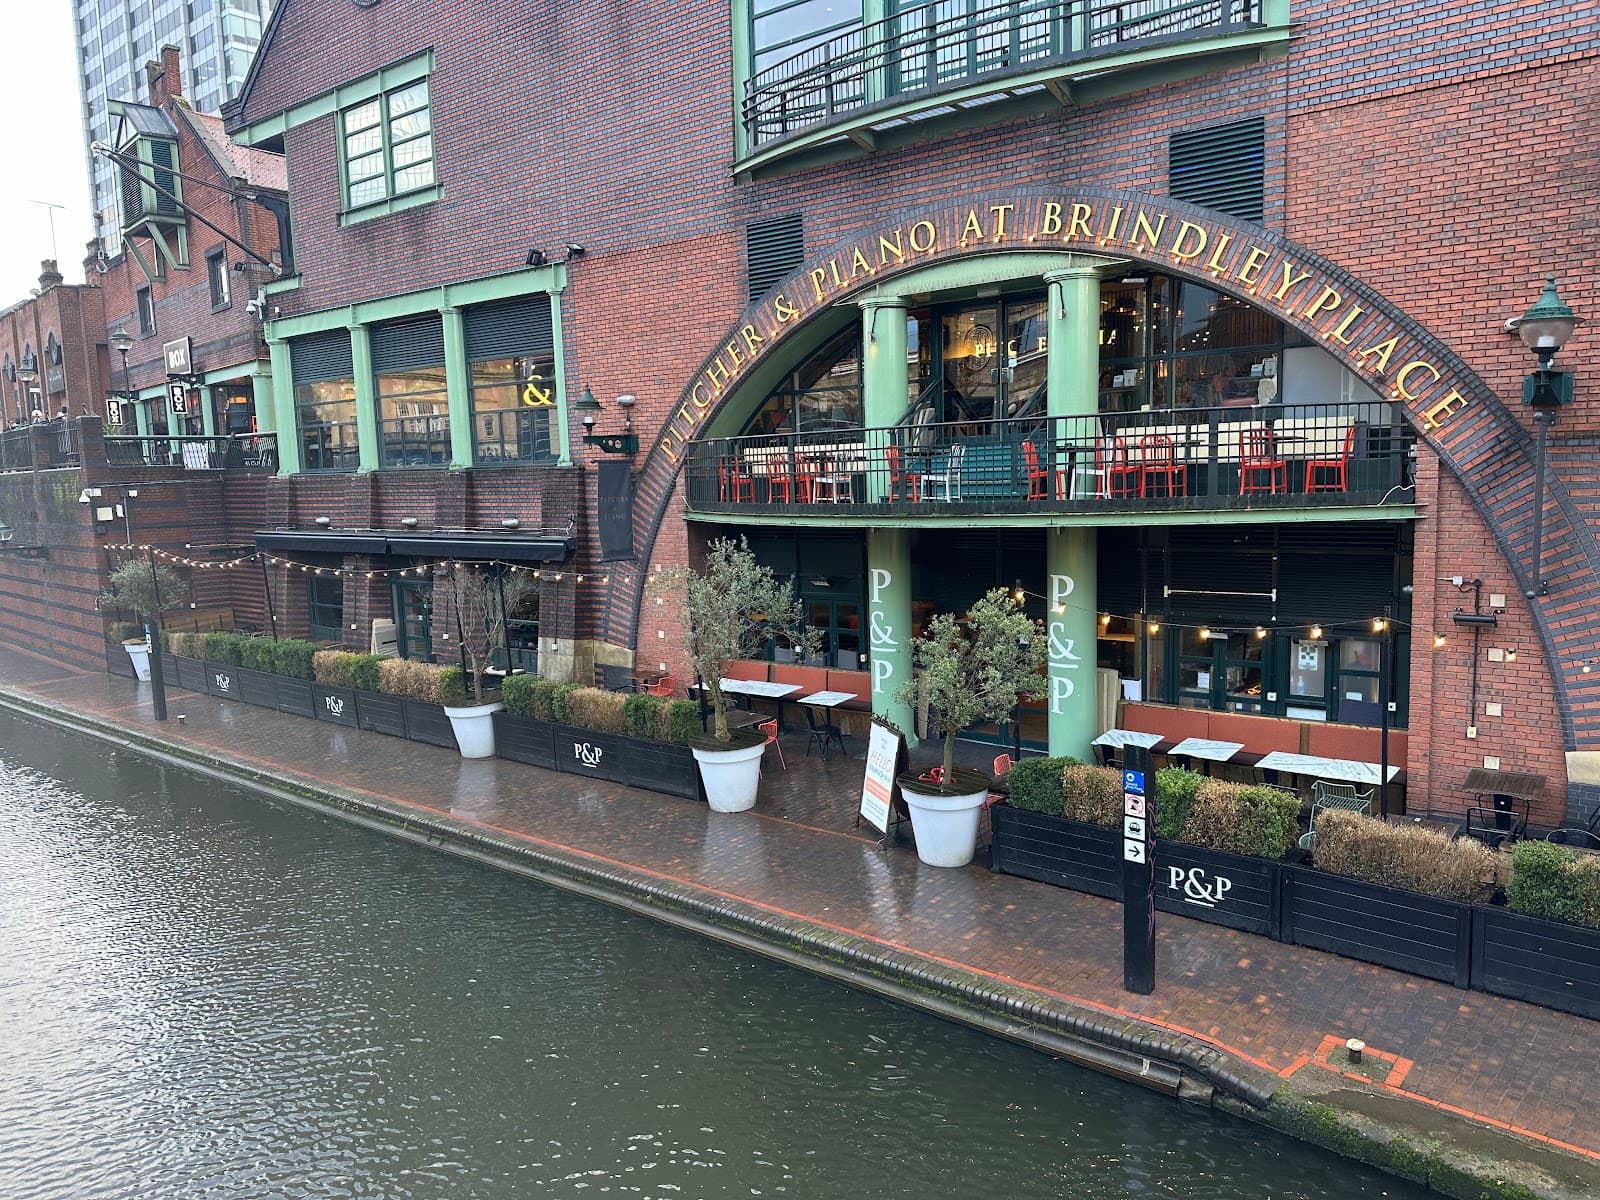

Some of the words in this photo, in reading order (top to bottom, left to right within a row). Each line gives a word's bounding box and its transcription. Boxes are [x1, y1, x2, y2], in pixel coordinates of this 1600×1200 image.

[661, 324, 764, 461] PITCHER
[775, 295, 799, 324] &
[811, 220, 936, 297] PIANO
[960, 204, 1014, 244] AT
[168, 347, 186, 369] BOX
[173, 386, 184, 412] BOX
[109, 401, 119, 423] BOX
[215, 673, 230, 690] P&P
[325, 695, 344, 714] P&P
[573, 742, 603, 766] P&P
[1168, 865, 1232, 903] P&P
